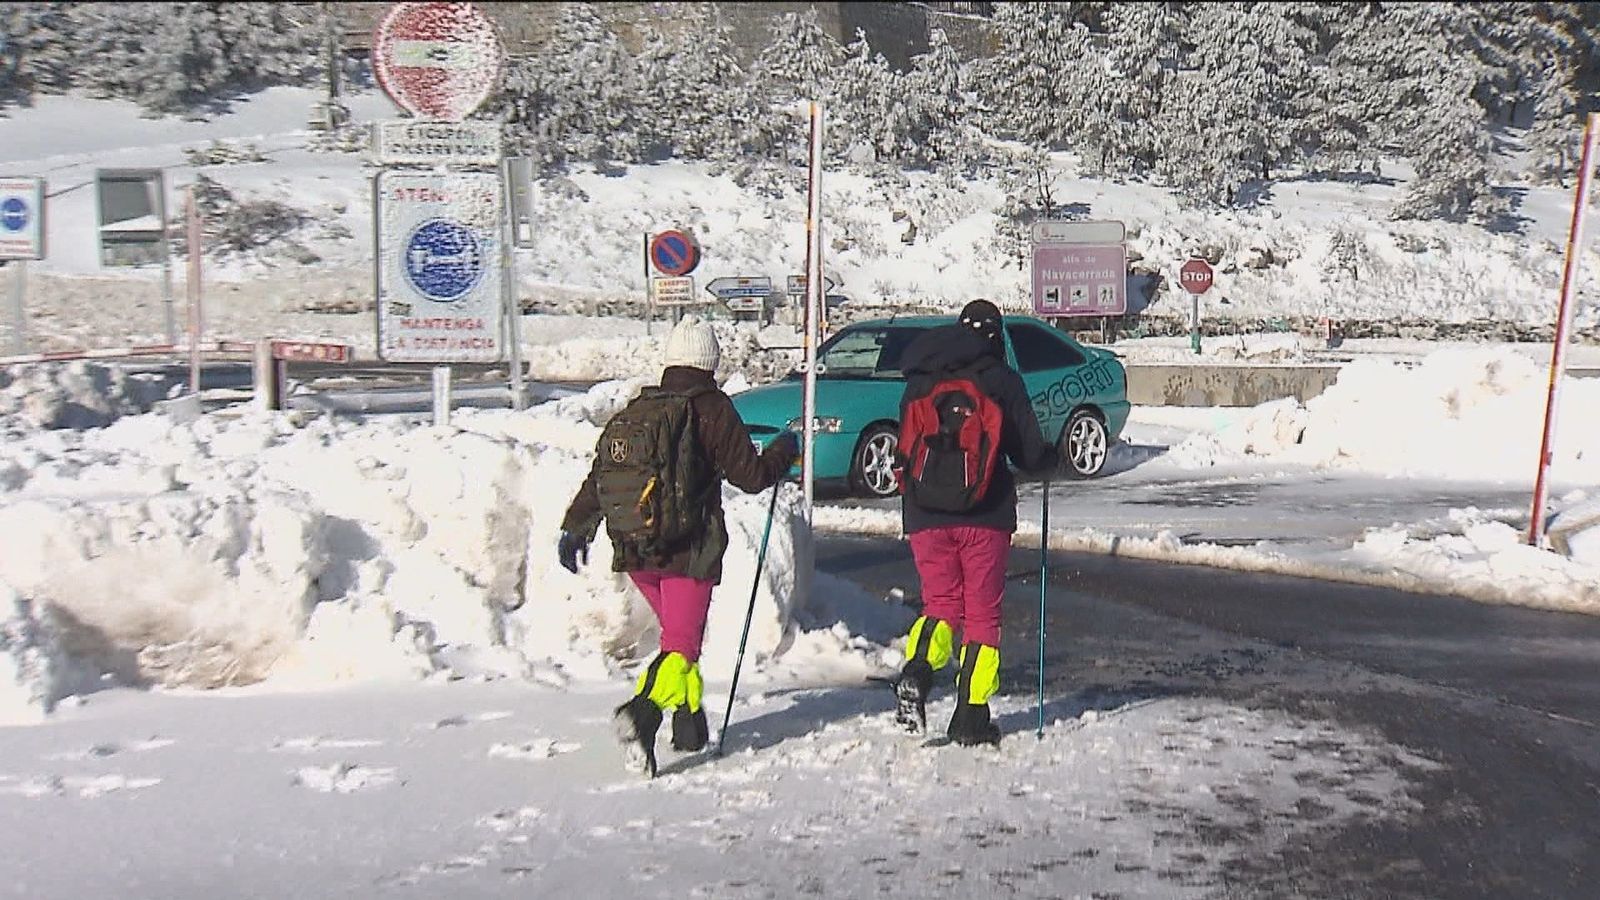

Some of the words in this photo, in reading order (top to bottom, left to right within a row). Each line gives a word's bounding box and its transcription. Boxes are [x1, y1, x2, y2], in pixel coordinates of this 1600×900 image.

[1042, 269, 1116, 280] Navacerrada
[1183, 271, 1211, 281] STOP
[401, 318, 485, 330] MANTENGA
[1030, 359, 1114, 423] SCORT
